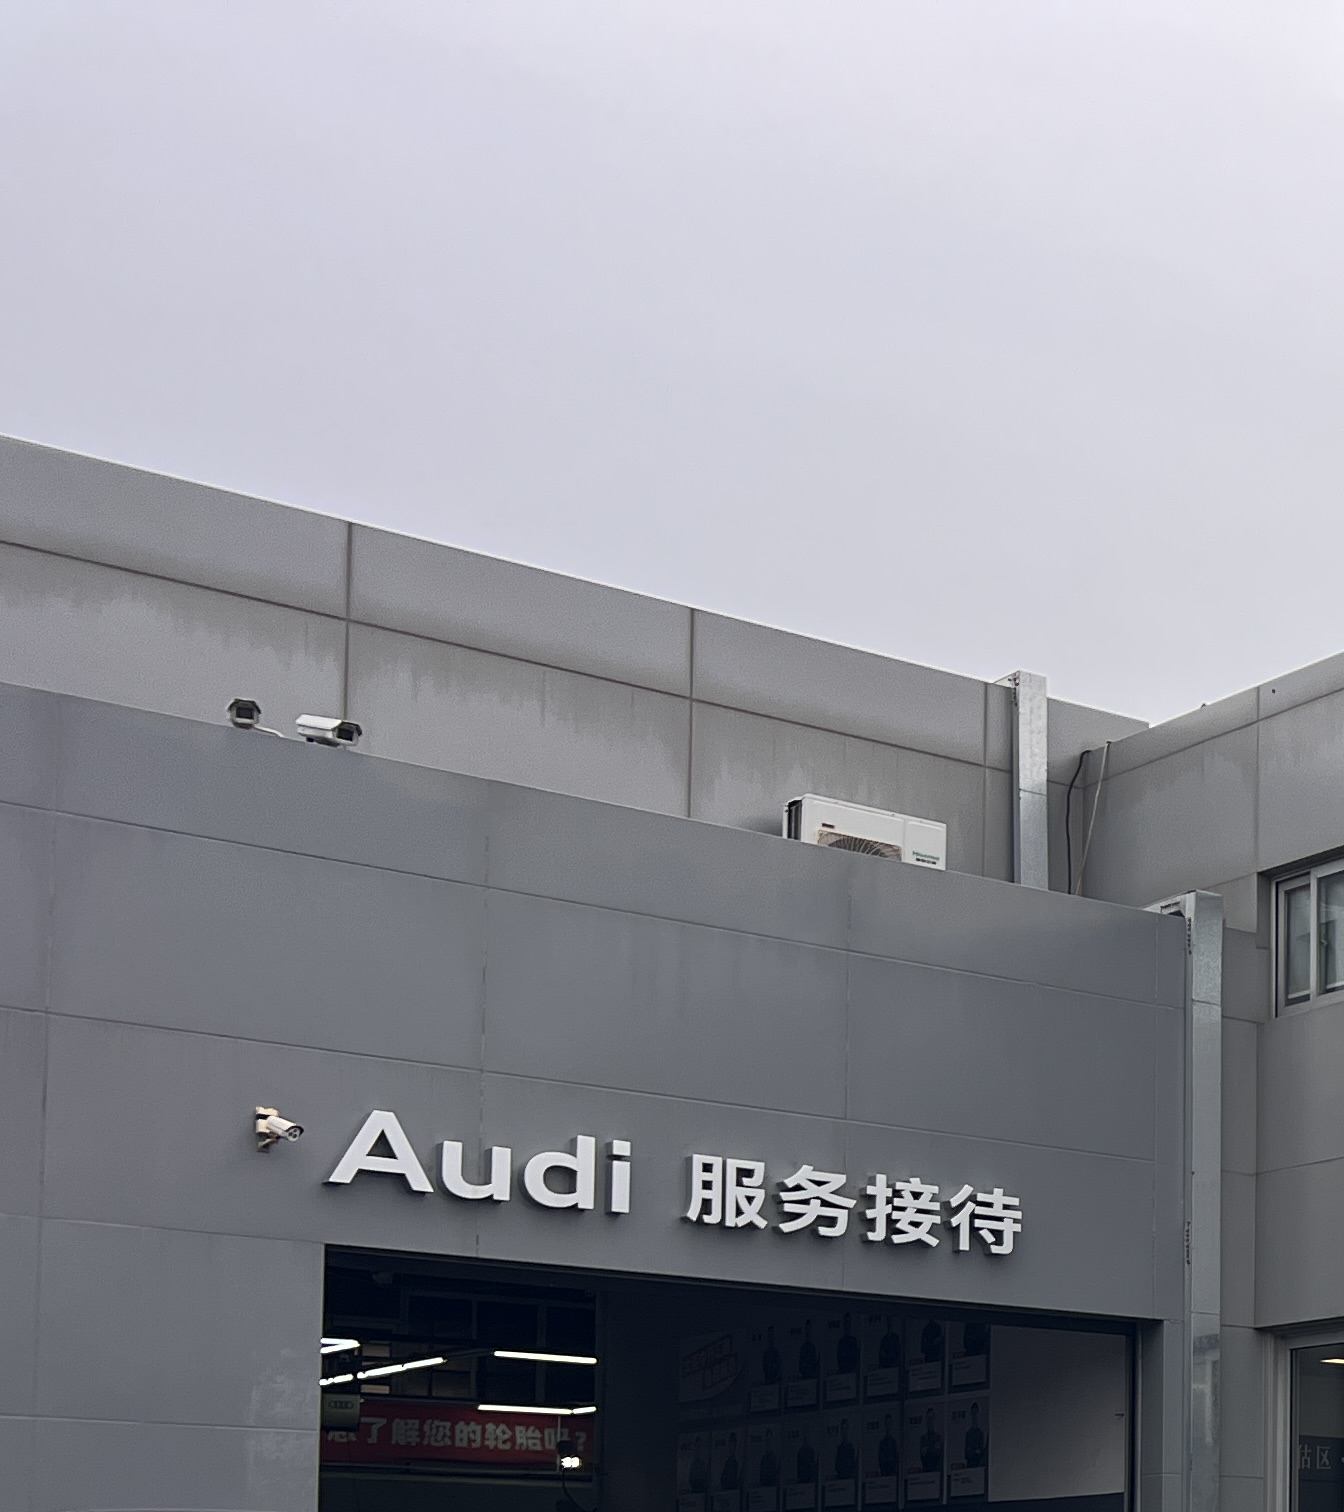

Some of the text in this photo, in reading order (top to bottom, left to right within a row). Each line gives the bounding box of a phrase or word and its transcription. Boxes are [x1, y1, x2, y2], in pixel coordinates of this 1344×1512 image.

[325, 1109, 1024, 1256] Audi 服务接待
